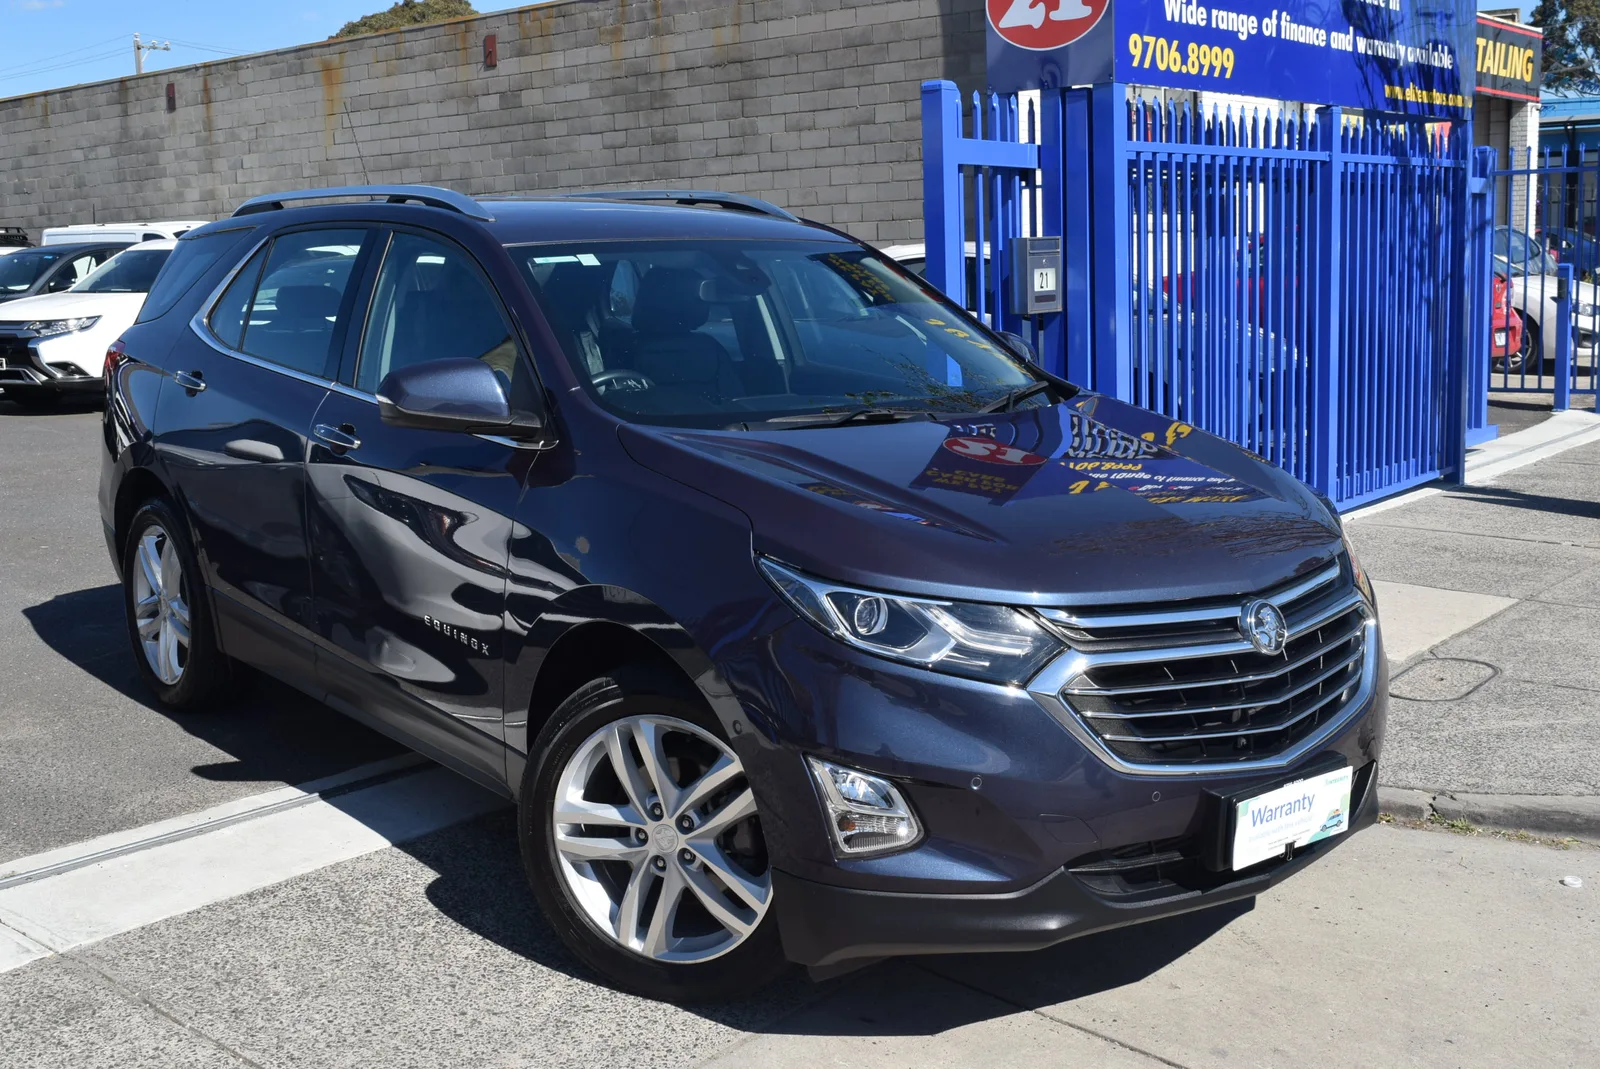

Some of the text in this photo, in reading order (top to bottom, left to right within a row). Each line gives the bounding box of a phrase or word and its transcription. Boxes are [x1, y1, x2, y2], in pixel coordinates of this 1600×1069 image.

[1128, 33, 1235, 79] 9706.8999
[1164, 0, 1454, 70] Wide range of finance and warranty available
[1476, 37, 1534, 83] TAILING
[1039, 271, 1049, 289] 21
[424, 614, 489, 656] EQUINOX
[1251, 793, 1315, 828] Warranty
